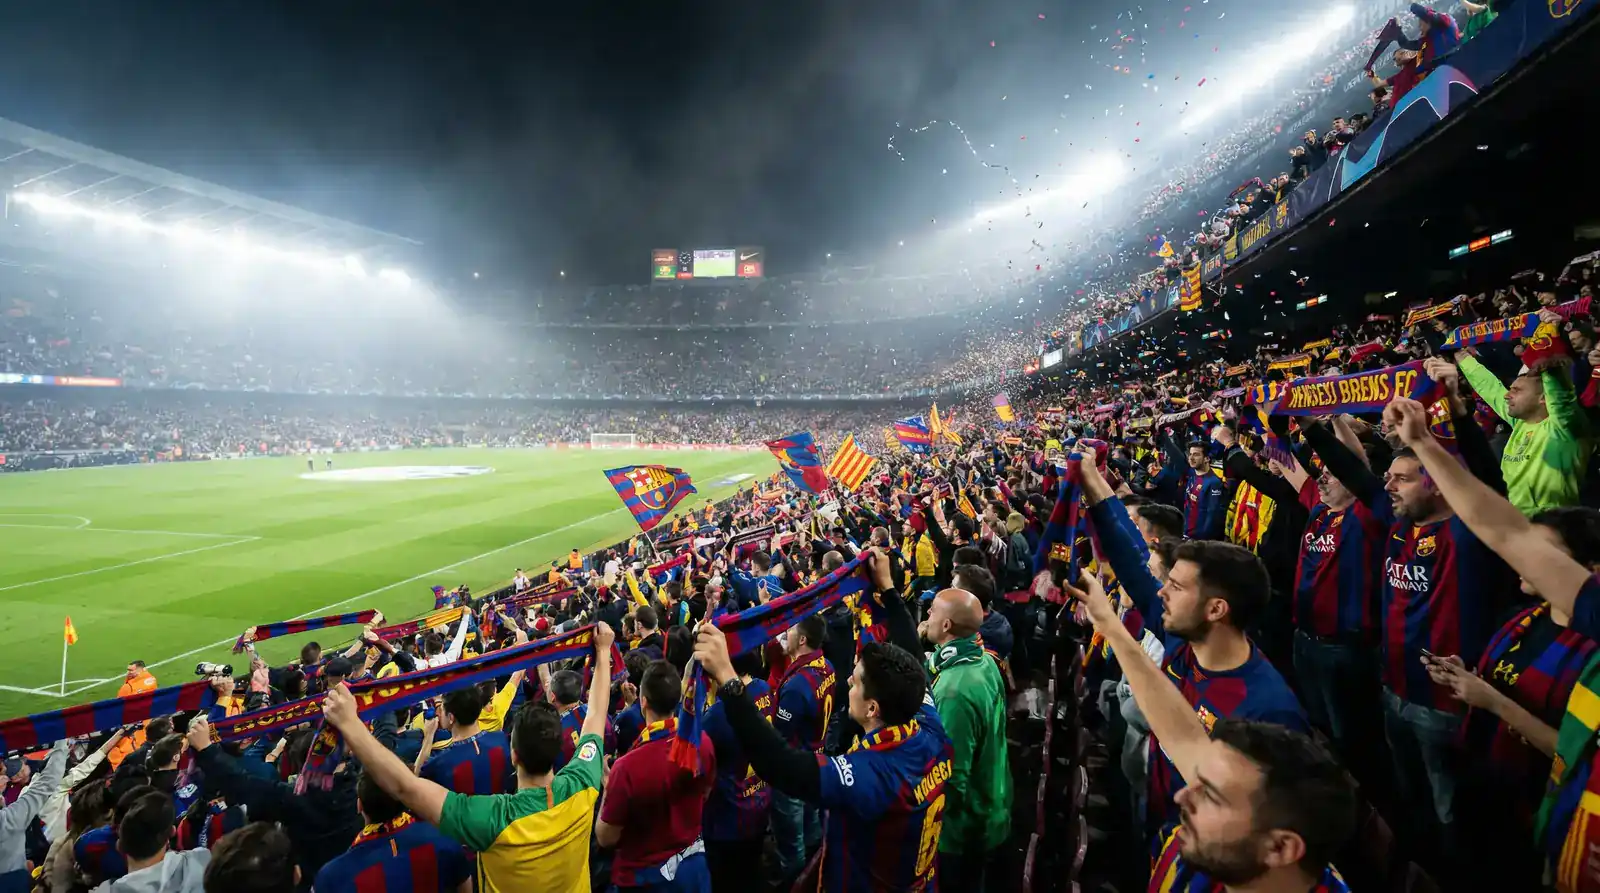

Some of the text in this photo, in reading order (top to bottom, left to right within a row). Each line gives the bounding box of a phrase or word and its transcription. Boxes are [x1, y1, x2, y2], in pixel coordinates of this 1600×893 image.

[1338, 373, 1389, 404] BRENS
[1394, 369, 1418, 398] FC
[1305, 533, 1335, 545] QAR
[915, 794, 946, 876] 6
